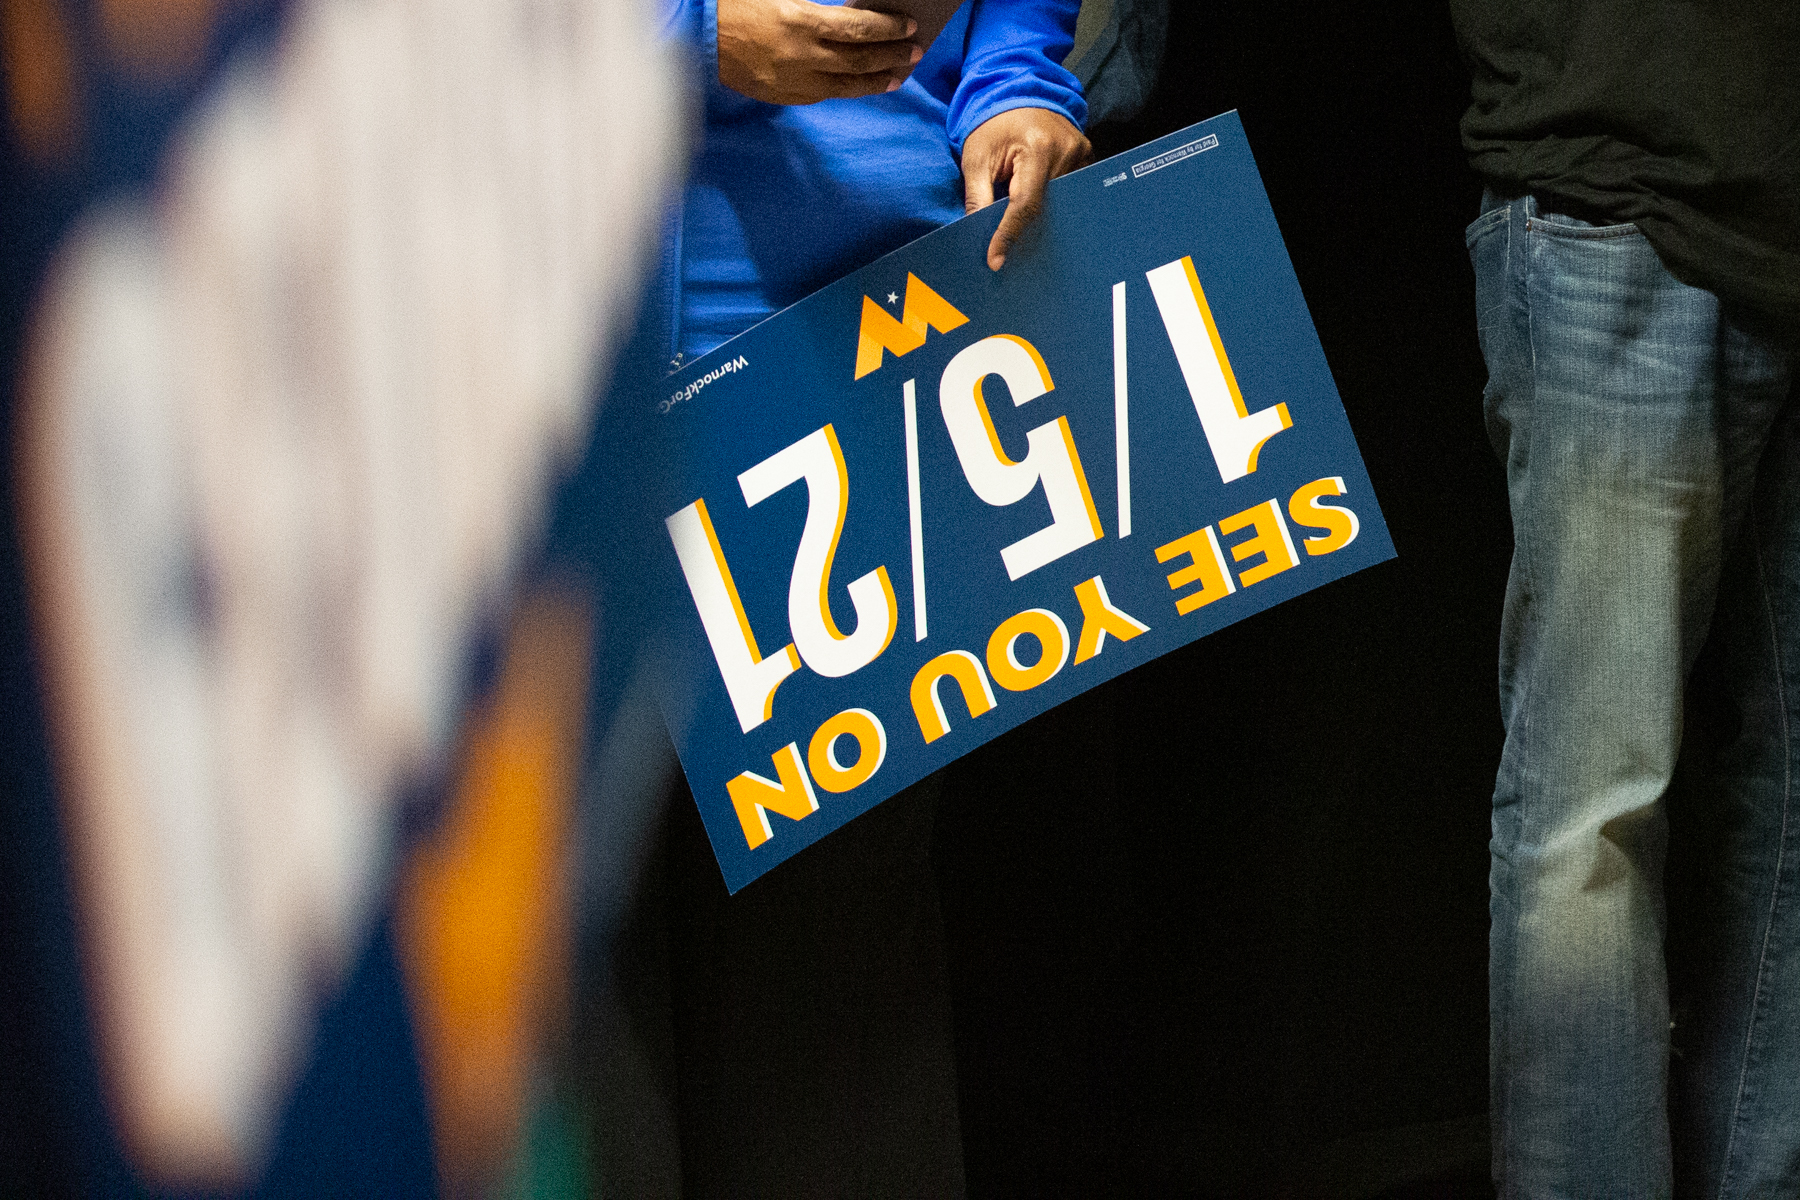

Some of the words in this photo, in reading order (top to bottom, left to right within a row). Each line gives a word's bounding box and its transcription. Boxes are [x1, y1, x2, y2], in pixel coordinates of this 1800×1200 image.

[665, 254, 1294, 735] 1/5/21
[1154, 475, 1361, 617] SEE
[909, 574, 1151, 745] YOU
[725, 707, 888, 851] ON
